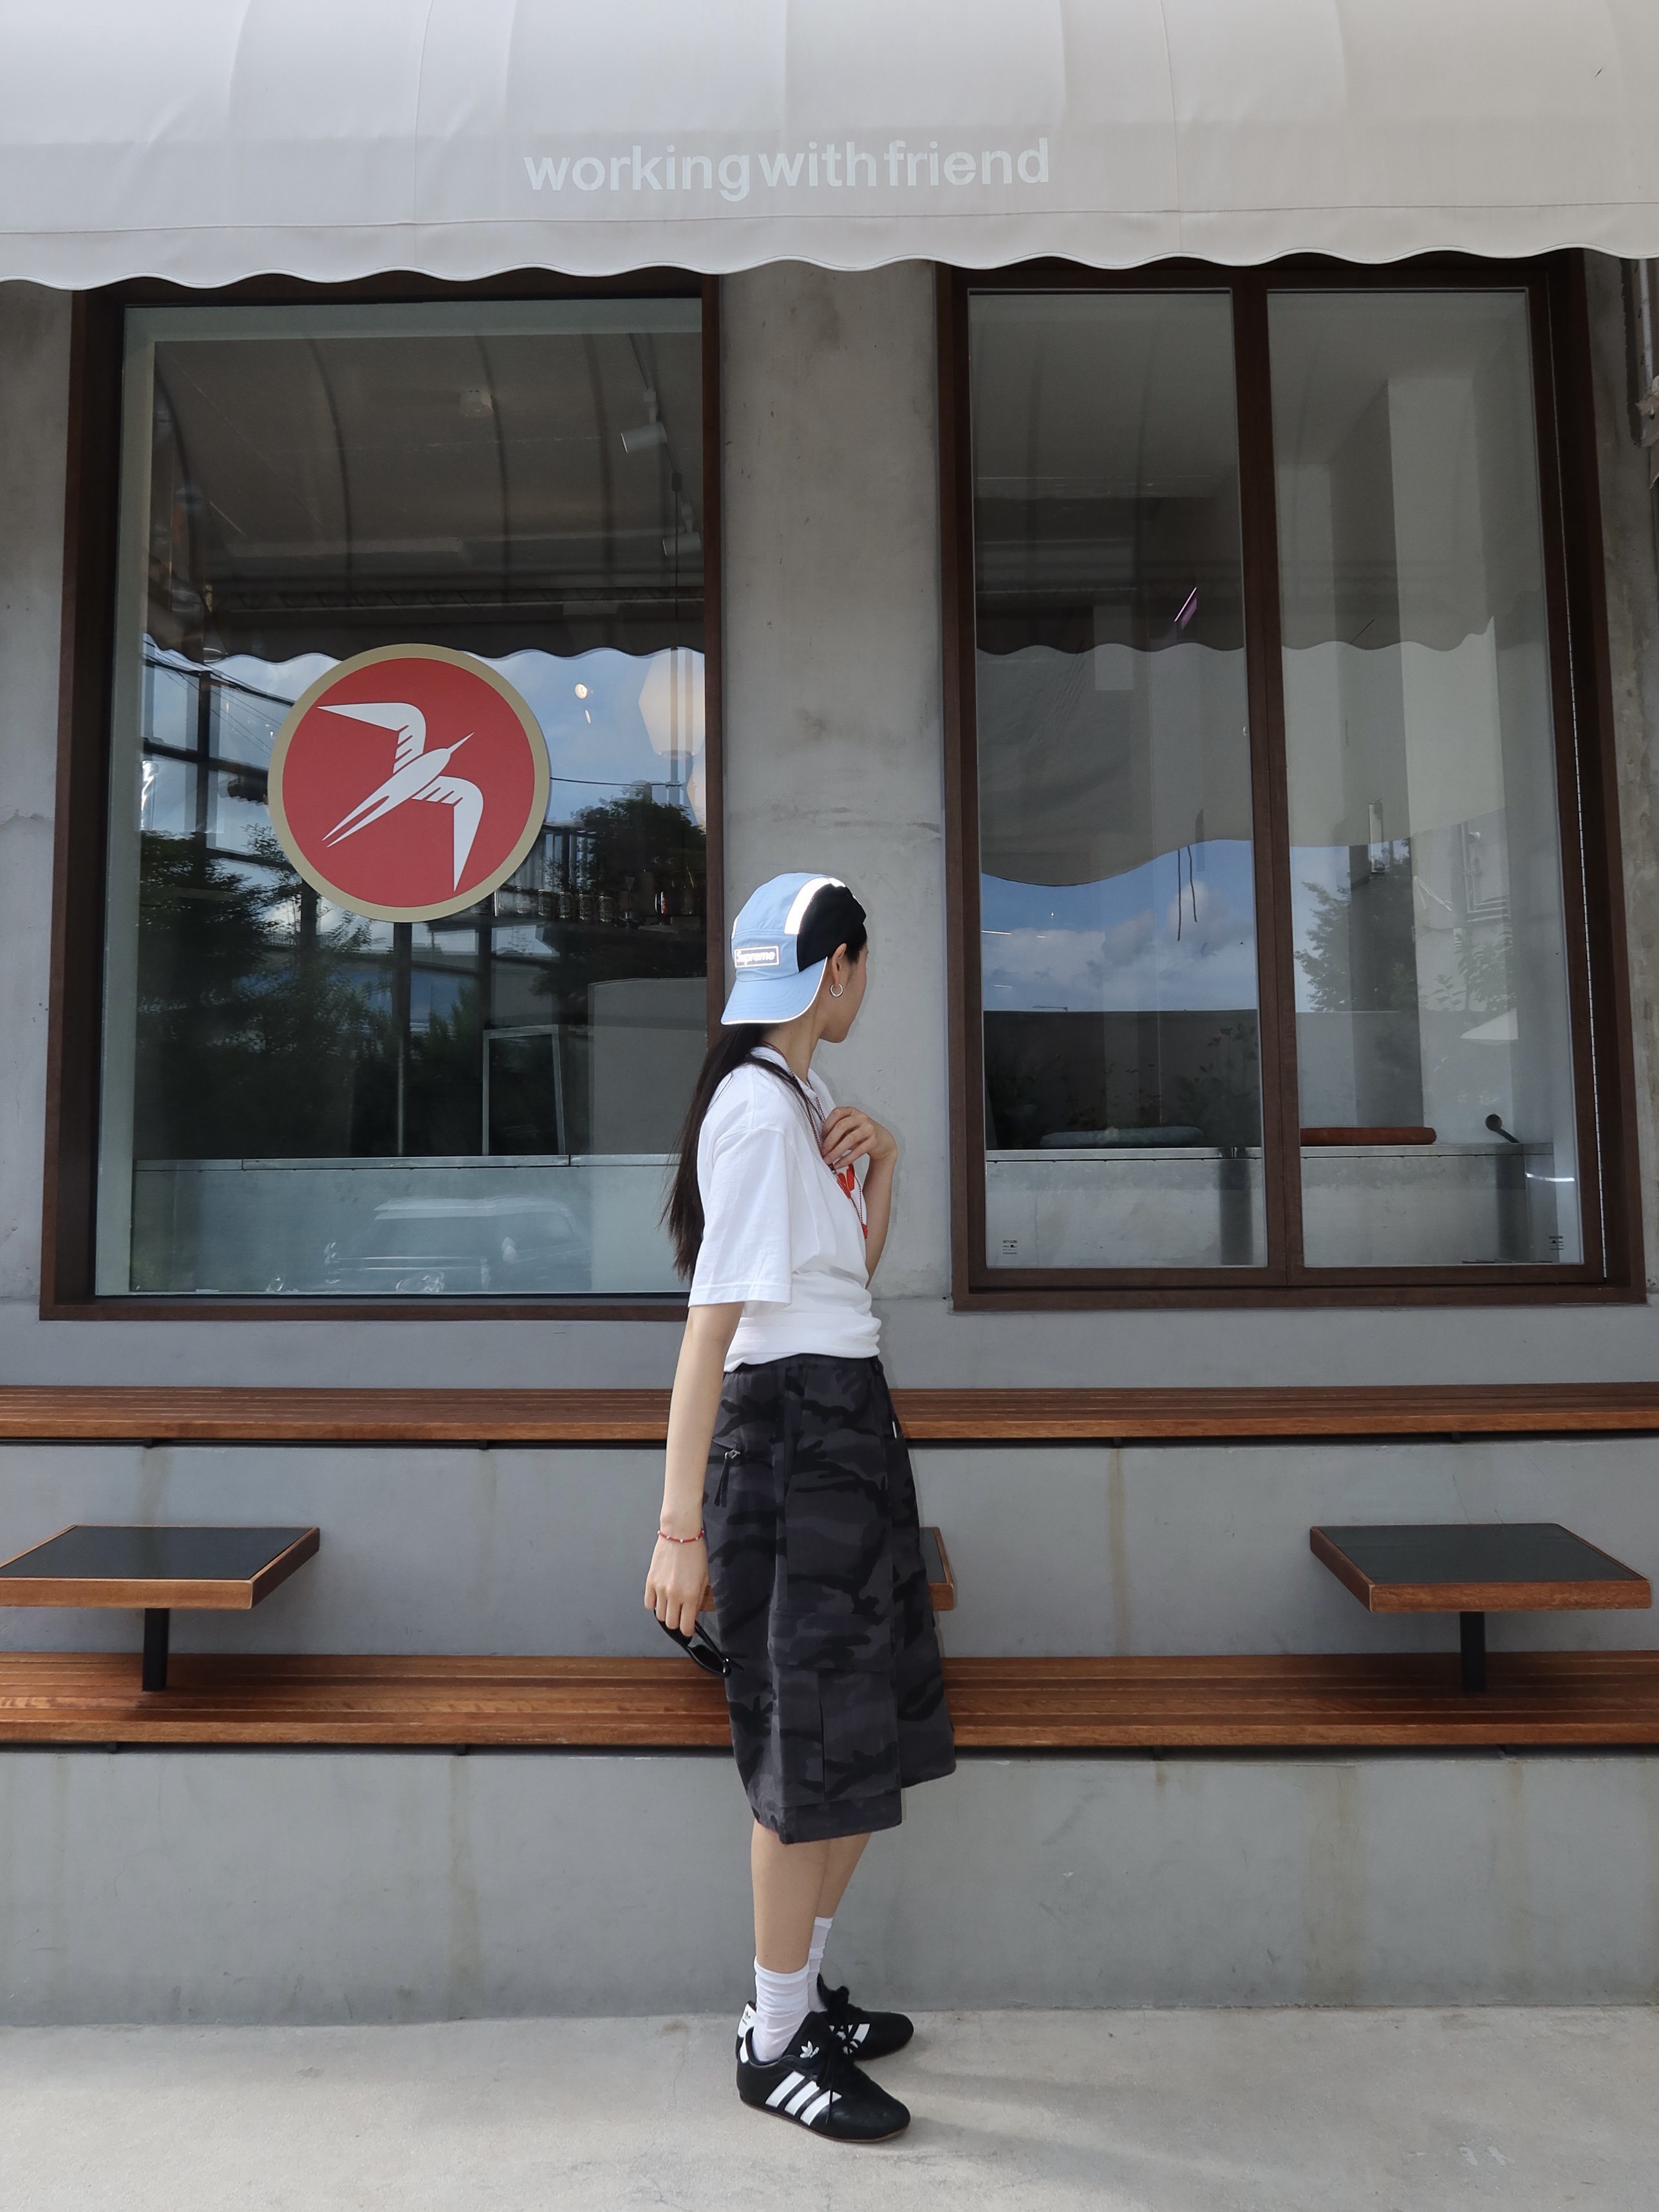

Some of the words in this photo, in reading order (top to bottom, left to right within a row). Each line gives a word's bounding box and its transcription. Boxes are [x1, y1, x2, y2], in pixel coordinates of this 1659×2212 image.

[524, 145, 750, 202] working
[758, 141, 876, 187] with
[885, 137, 1049, 186] friend
[736, 950, 776, 965] Supreme
